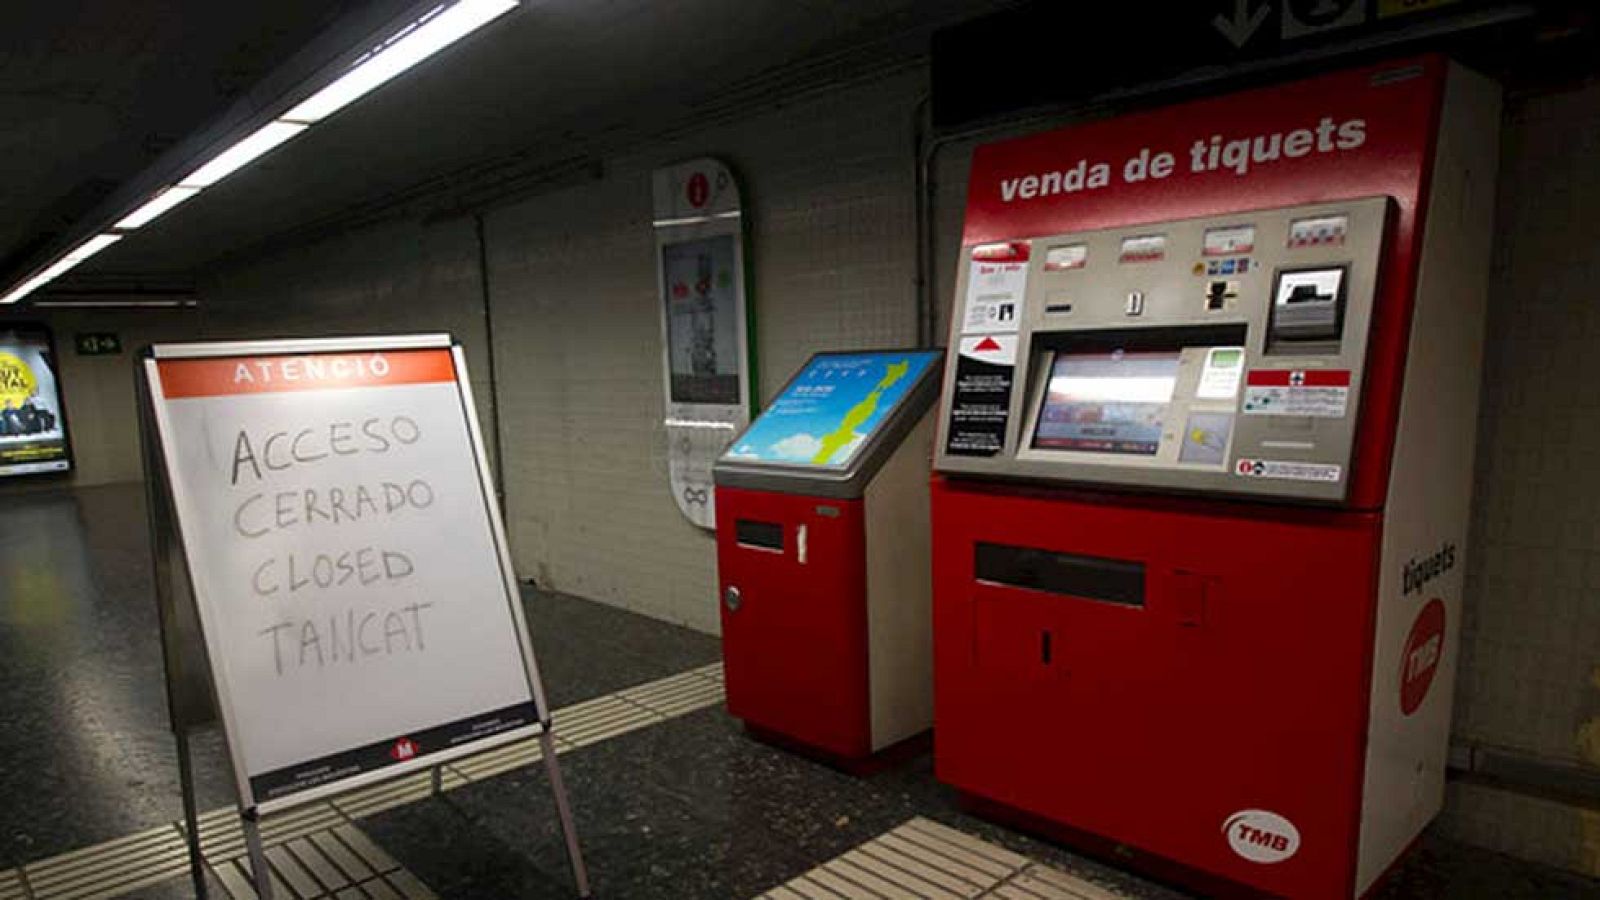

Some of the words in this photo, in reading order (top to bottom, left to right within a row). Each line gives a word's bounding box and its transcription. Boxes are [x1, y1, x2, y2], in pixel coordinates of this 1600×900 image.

[1001, 161, 1110, 201] venda
[1123, 149, 1175, 183] de
[1190, 117, 1366, 175] tiquets
[234, 353, 390, 384] ATENCIÓ
[231, 416, 420, 486] ACCESO
[234, 479, 434, 538] CERRADO
[253, 548, 414, 596] CLOSED
[1402, 541, 1456, 595] tiquets
[257, 602, 434, 677] TANCAT
[1238, 824, 1290, 851] TMB
